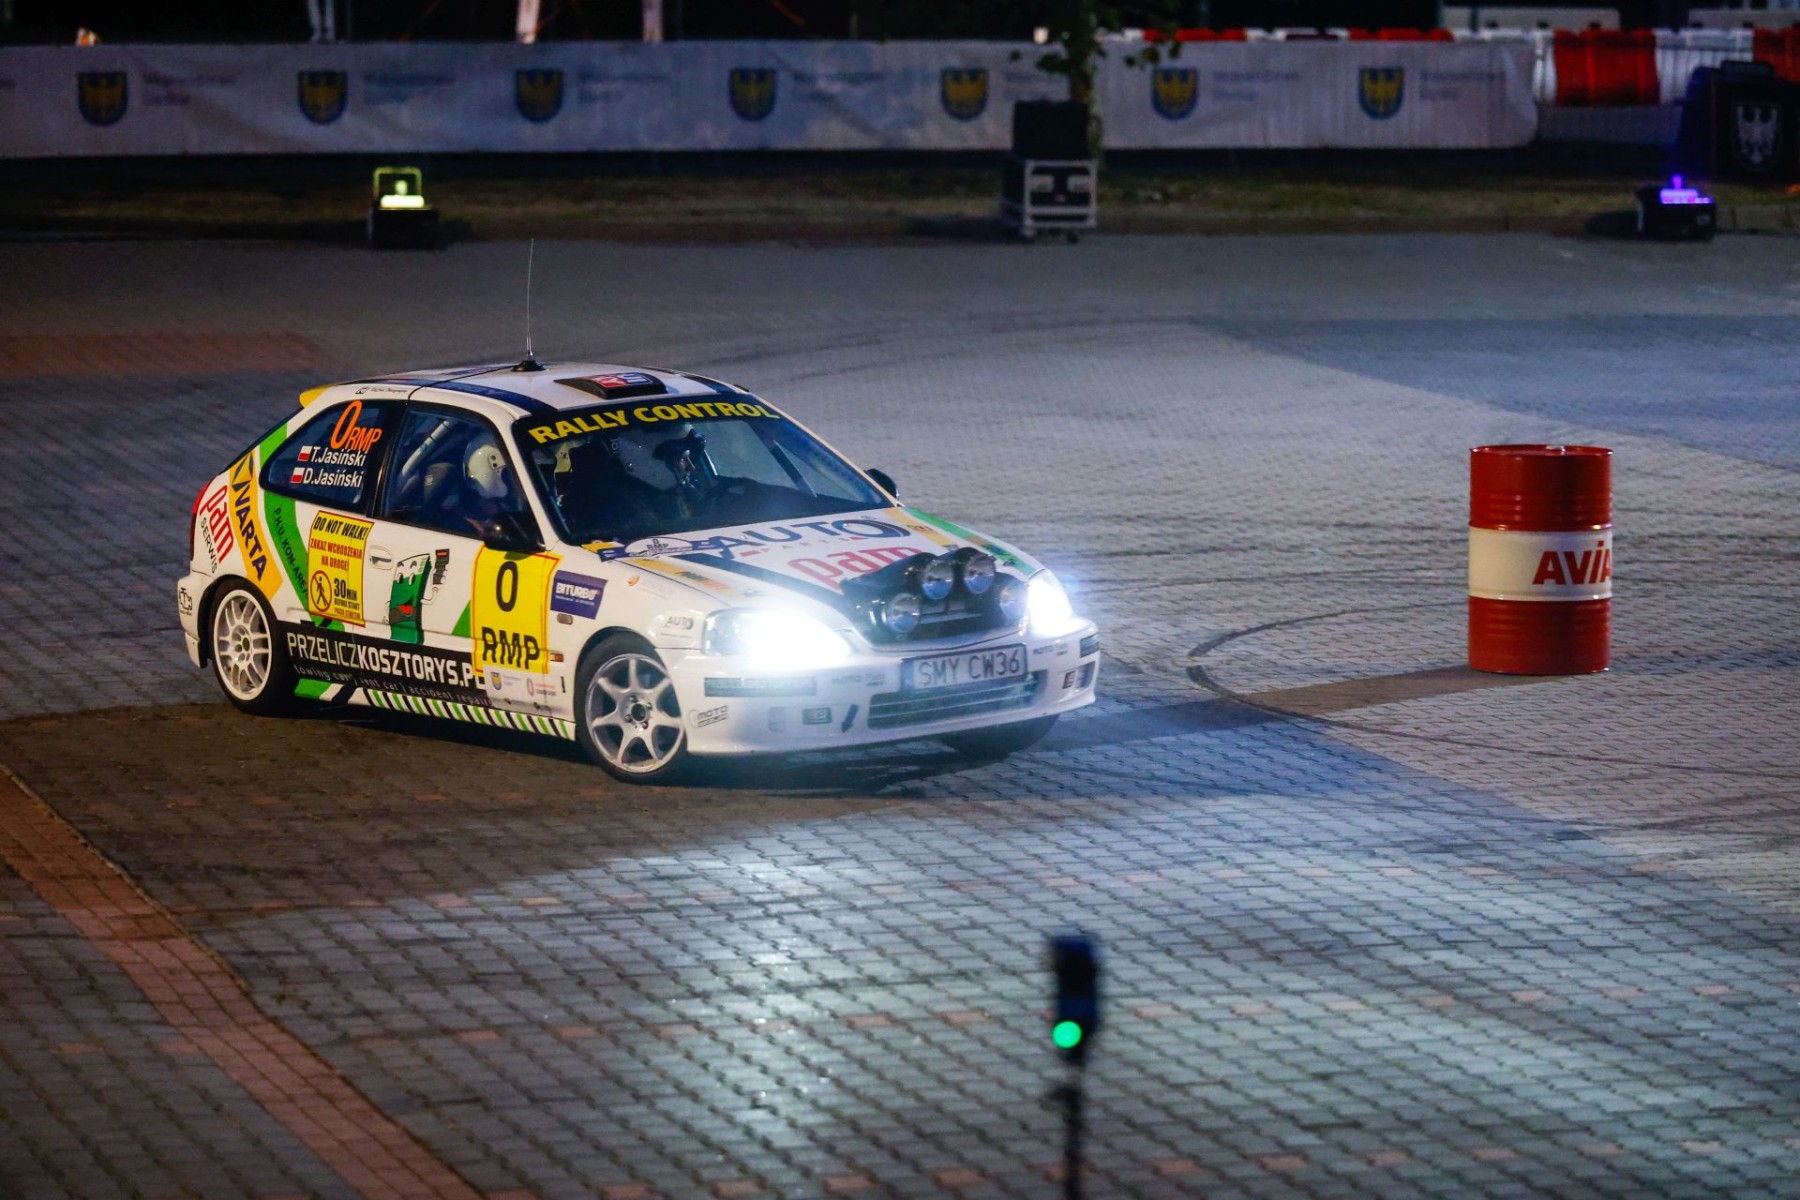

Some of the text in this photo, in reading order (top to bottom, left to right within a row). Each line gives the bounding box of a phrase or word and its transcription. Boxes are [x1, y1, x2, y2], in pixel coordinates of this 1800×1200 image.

[528, 402, 780, 444] RALLY CONTROL
[303, 467, 364, 488] D.Jasiński
[310, 446, 367, 467] T.Jasiński
[199, 484, 235, 564] pam
[234, 484, 267, 582] VARTA
[313, 516, 369, 541] DO NOT WALK!
[200, 517, 218, 574] SERWIS
[334, 577, 346, 599] 30
[496, 560, 519, 612] 0
[481, 626, 540, 670] RMP
[917, 659, 960, 686] SMY
[967, 650, 1020, 680] CW36
